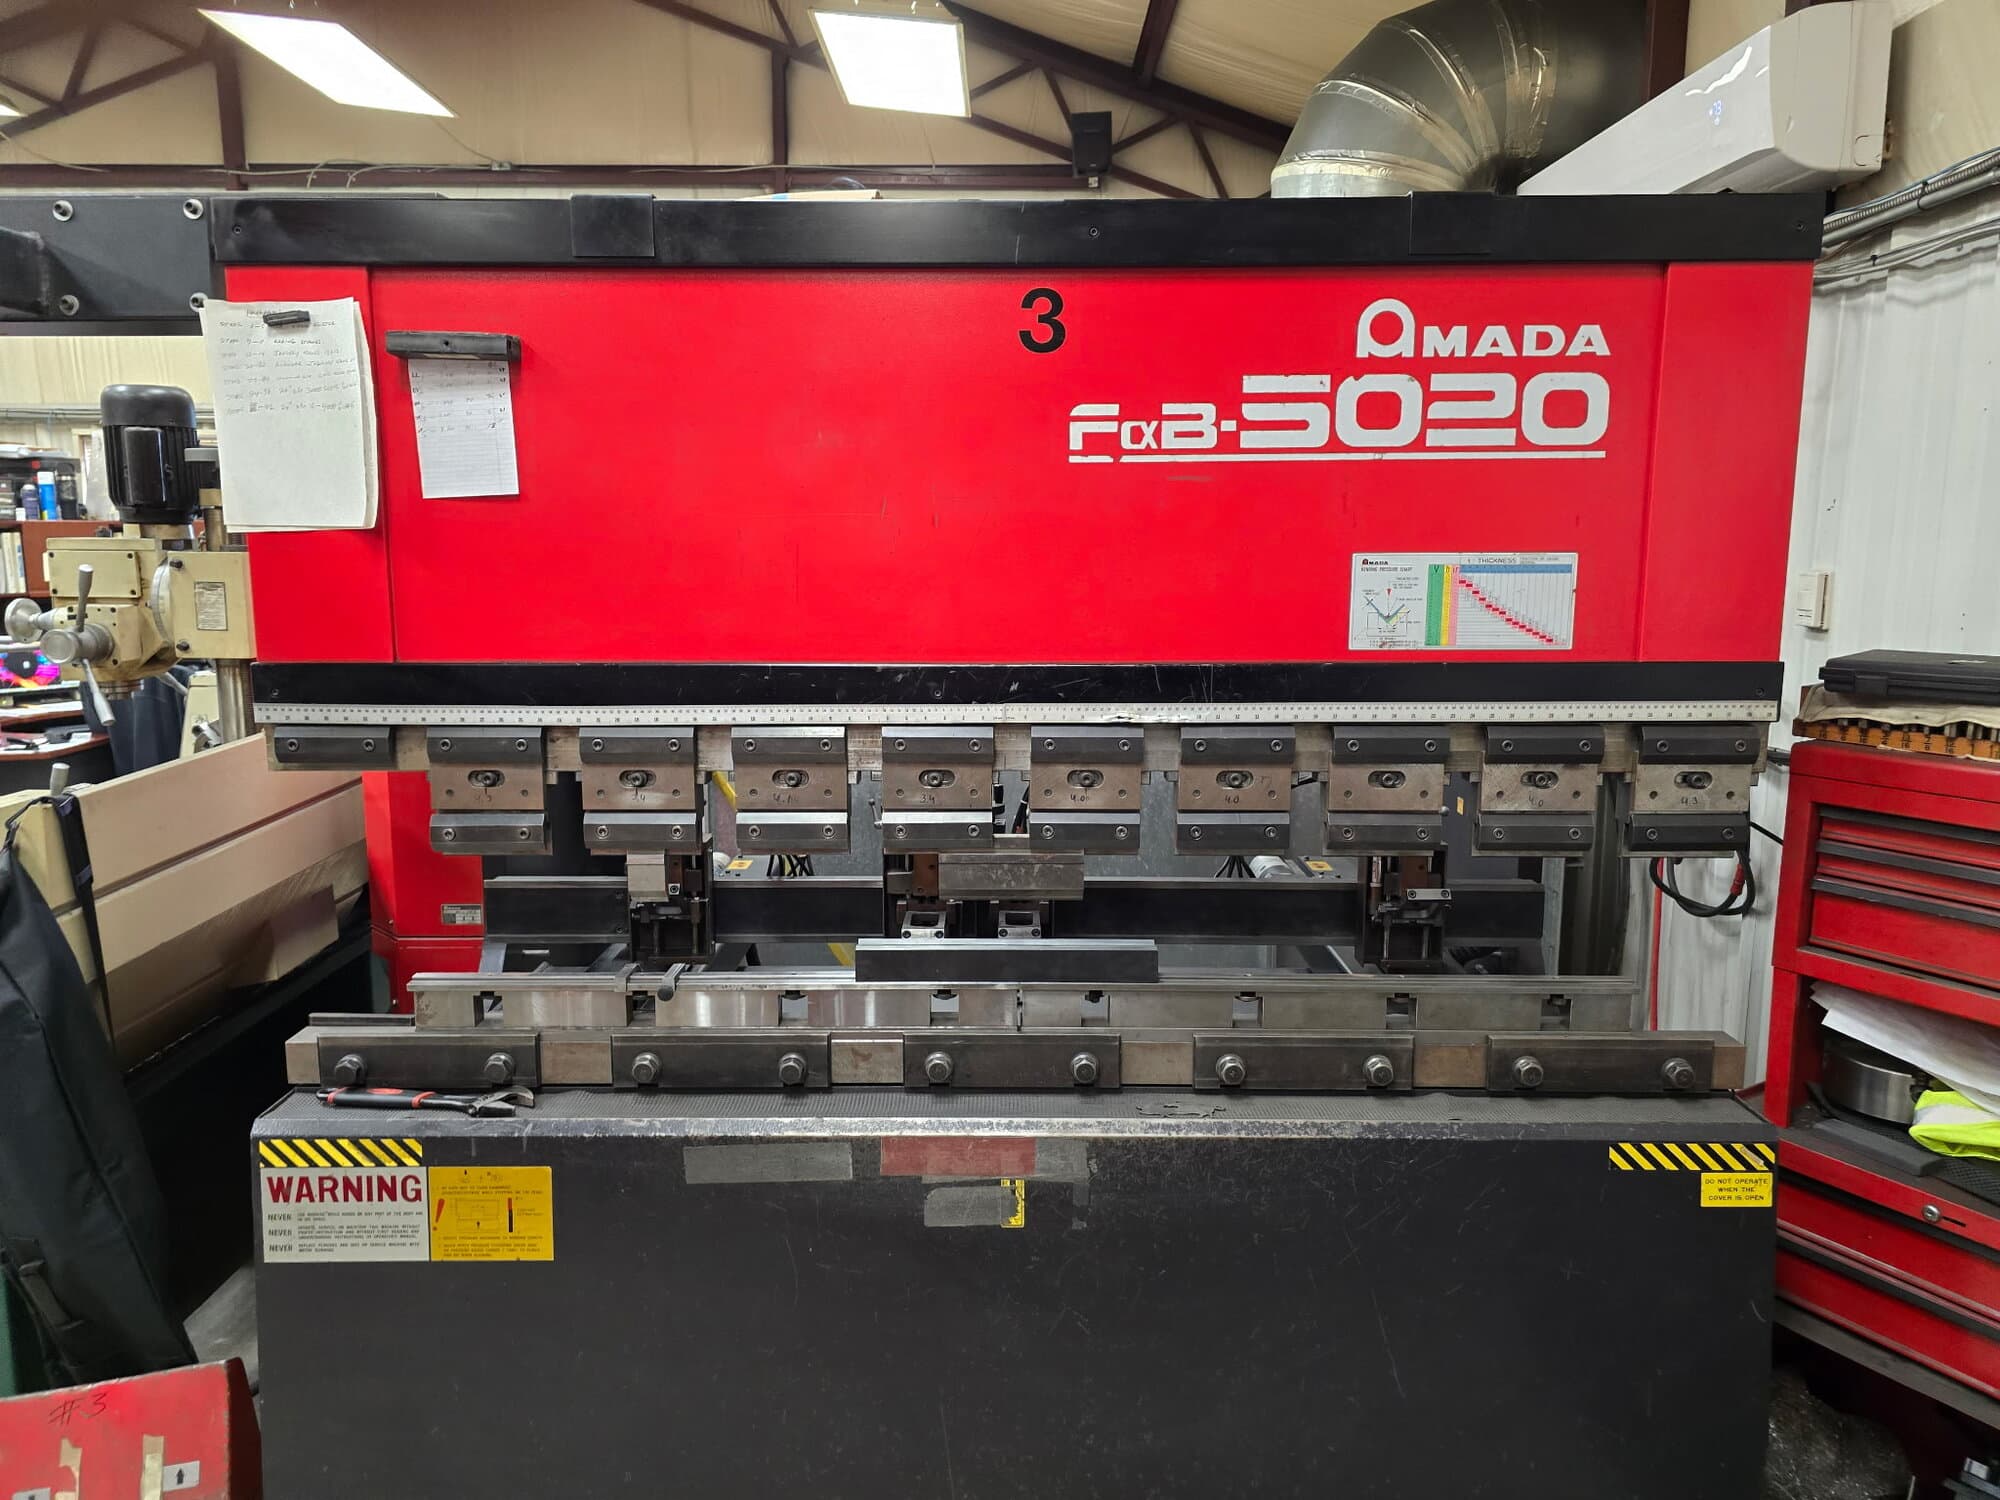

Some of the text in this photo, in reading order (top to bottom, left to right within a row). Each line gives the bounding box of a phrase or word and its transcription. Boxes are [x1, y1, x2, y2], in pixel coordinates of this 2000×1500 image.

[1018, 288, 1066, 354] 3
[1356, 298, 1611, 359] AMADA
[267, 1174, 423, 1204] WARNING
[267, 1213, 292, 1221] NEVER
[268, 1229, 292, 1237] NEVER
[269, 1244, 293, 1252] NEVER
